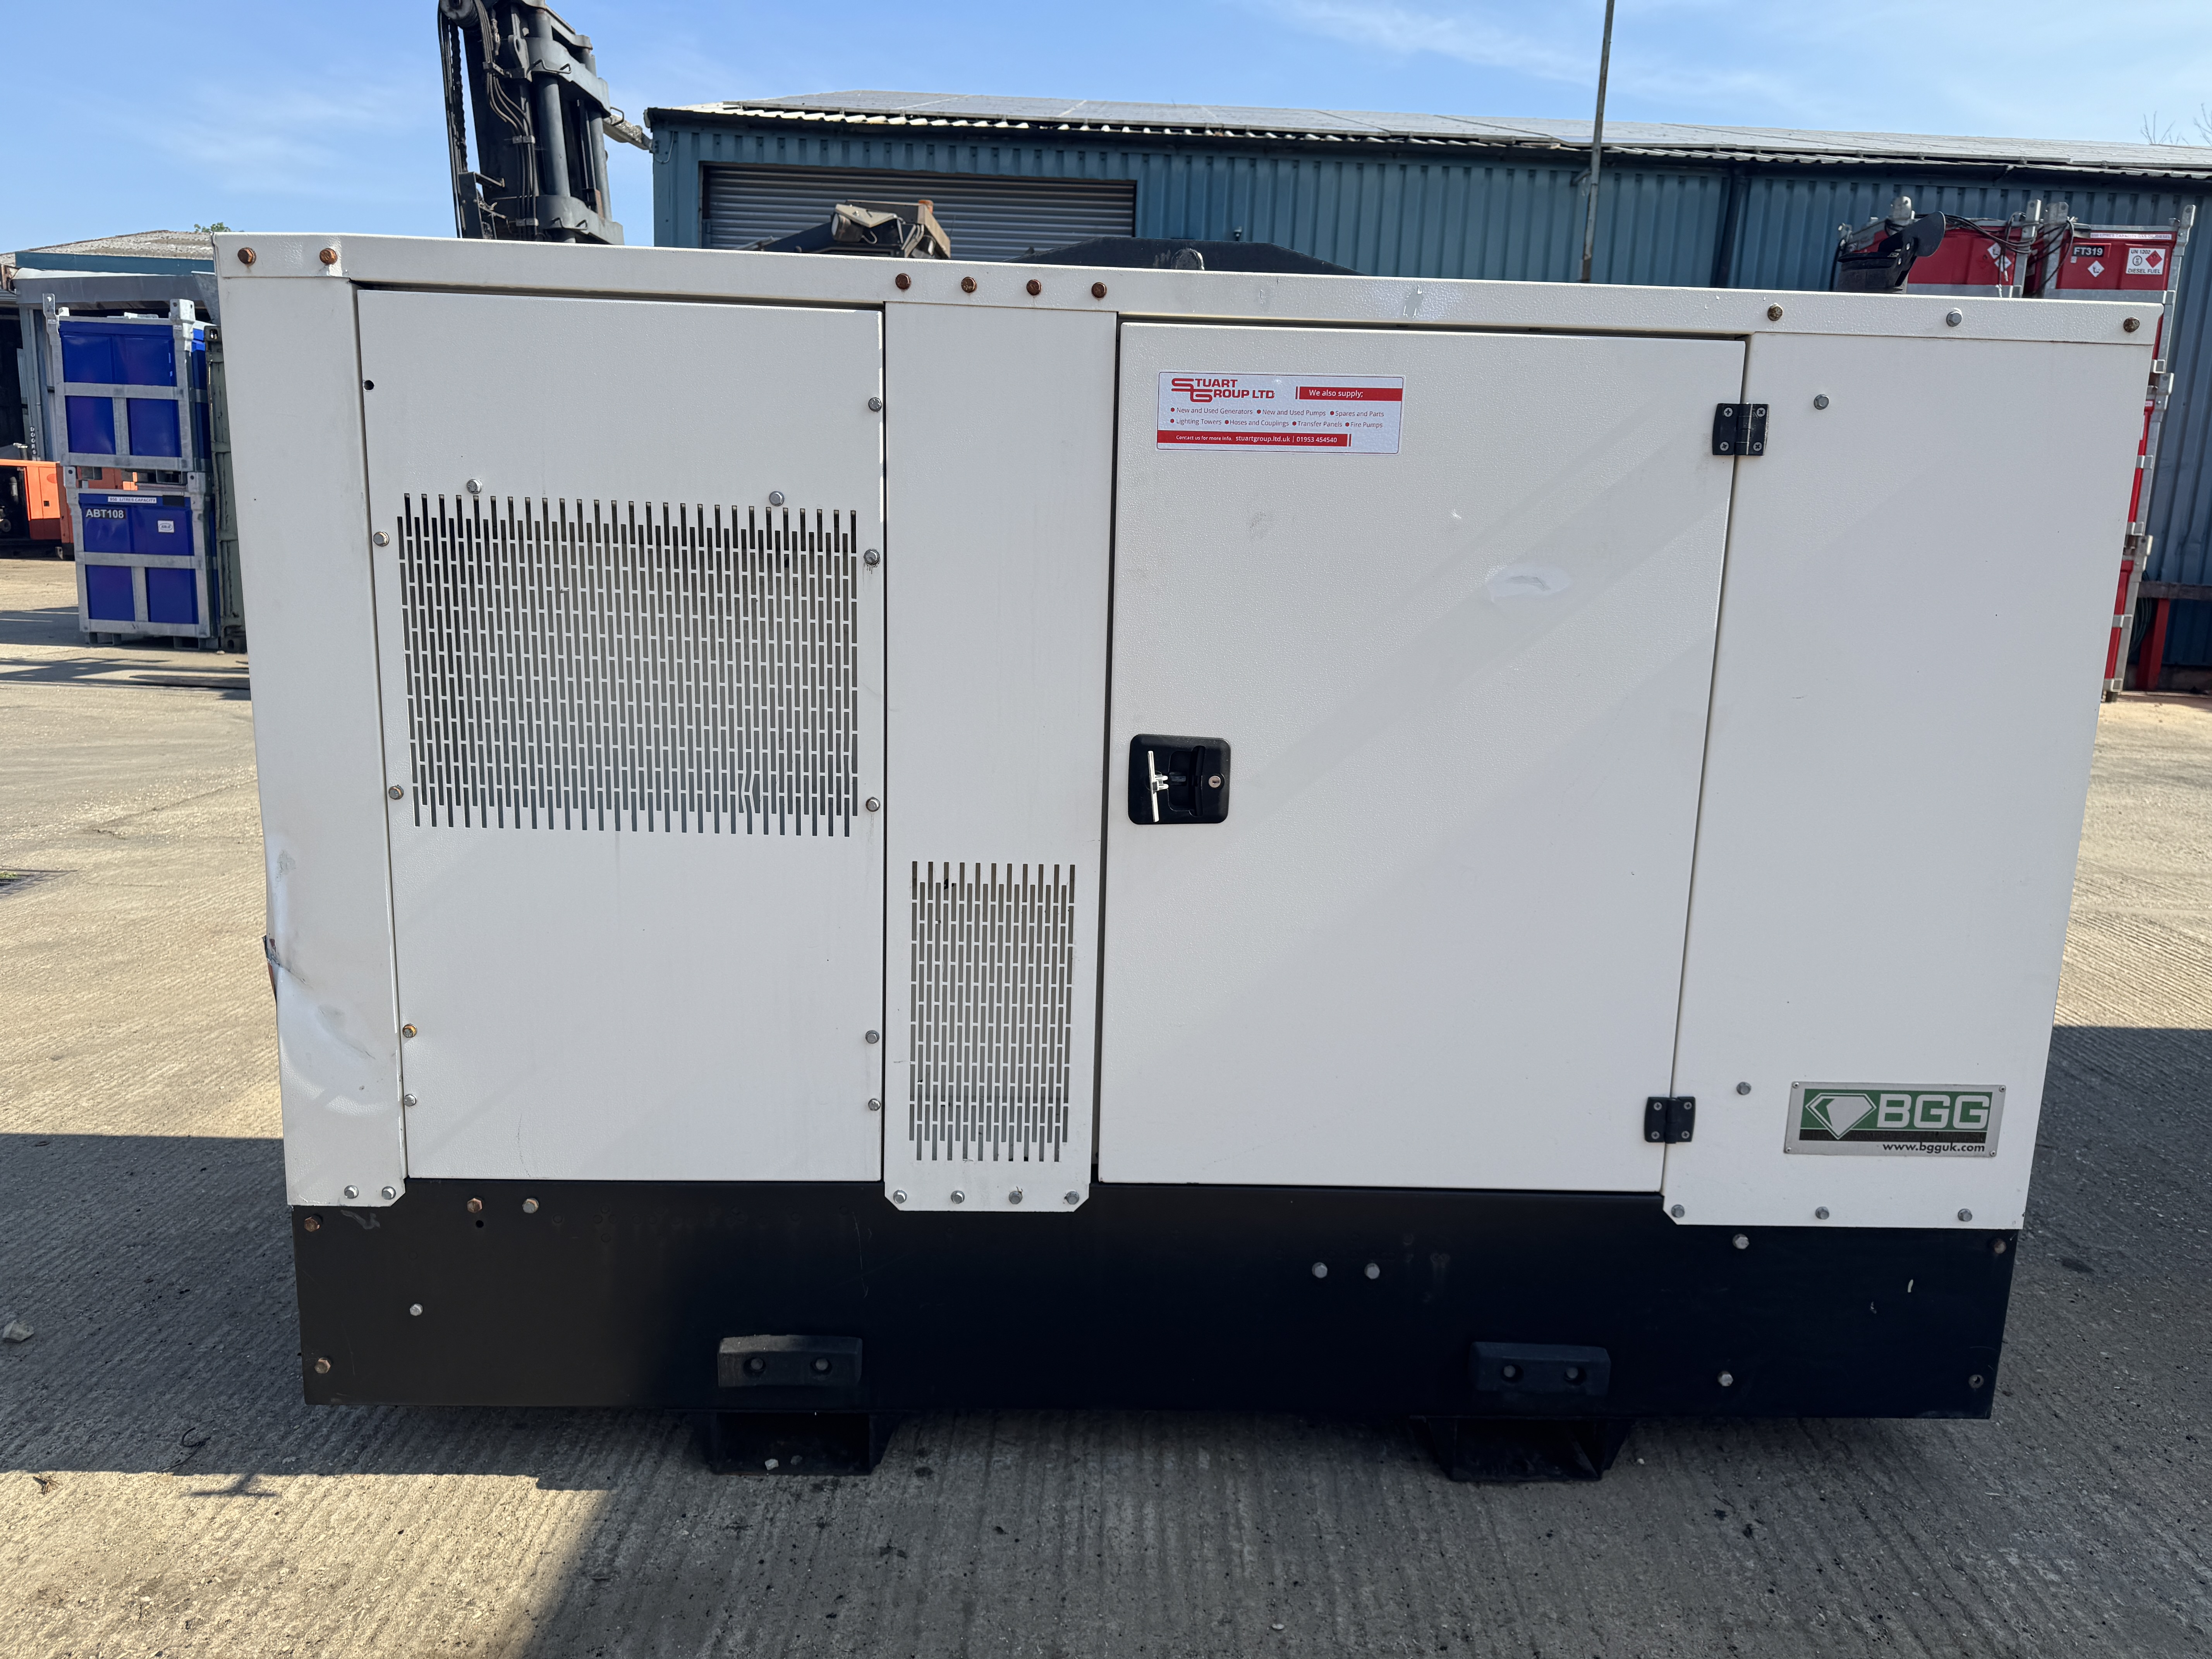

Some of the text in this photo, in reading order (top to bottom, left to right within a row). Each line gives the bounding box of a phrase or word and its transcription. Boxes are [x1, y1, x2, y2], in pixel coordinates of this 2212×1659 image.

[2073, 247, 2103, 256] FT319
[1171, 378, 1238, 392] STUART
[1190, 389, 1275, 402] GROUP LTD
[86, 509, 124, 518] ABT108
[1877, 1094, 1990, 1129] BGG
[1883, 1141, 1985, 1154] www.bgguk.com
